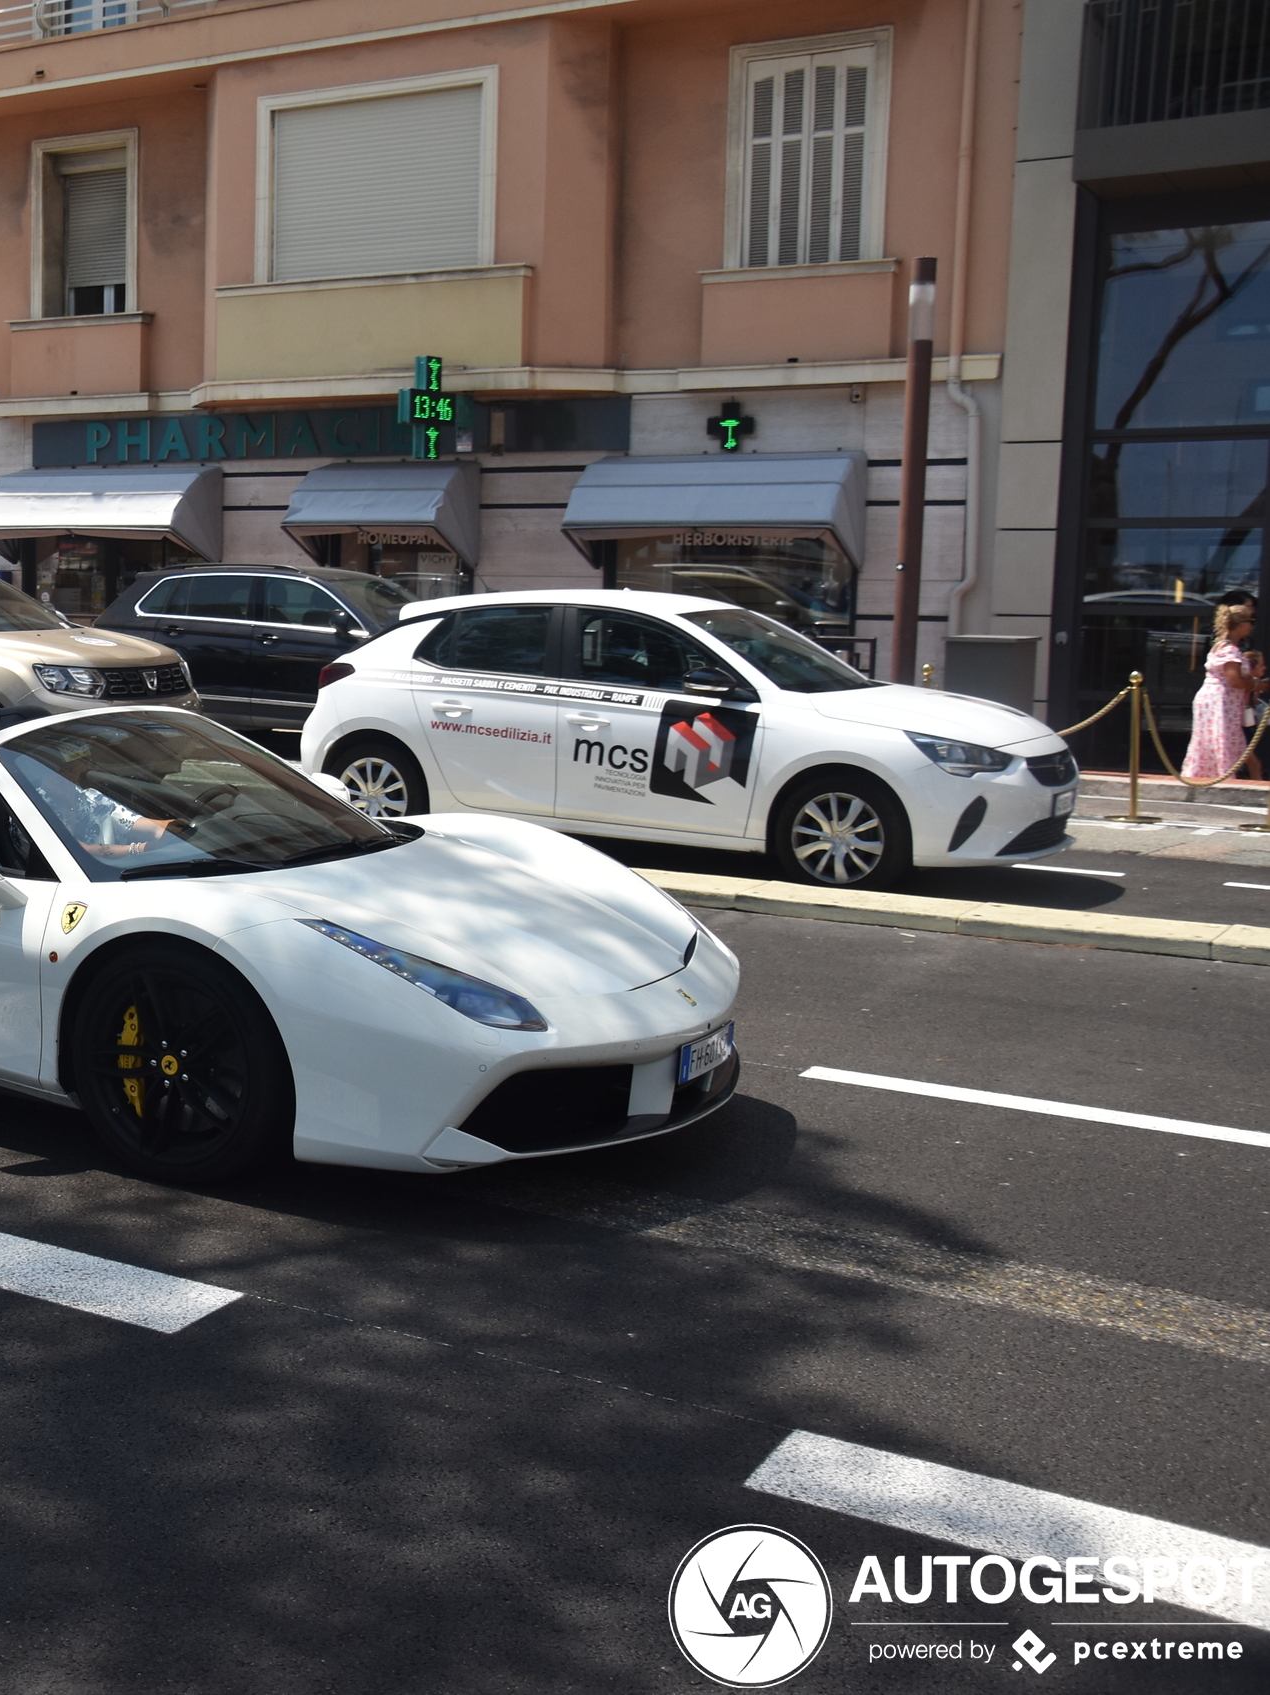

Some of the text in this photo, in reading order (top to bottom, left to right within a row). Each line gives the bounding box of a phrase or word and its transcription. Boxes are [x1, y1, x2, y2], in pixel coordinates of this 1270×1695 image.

[414, 396, 452, 421] 13:46
[672, 532, 794, 547] HERBORISTERIE
[420, 554, 454, 564] VICHY
[440, 677, 473, 687] MASSETTI
[473, 680, 498, 689] SABBIA
[504, 682, 537, 692] CEMENTO
[559, 687, 605, 699] INDUSTRIALI
[611, 693, 640, 704] RAMPE
[431, 720, 552, 744] www.mcsedilizia.it
[573, 737, 649, 773] mcs
[594, 776, 646, 789] INNOVATIVA PER
[605, 769, 647, 781] TECNOLOGIA
[593, 783, 646, 797] PAVIMENTAZIONI
